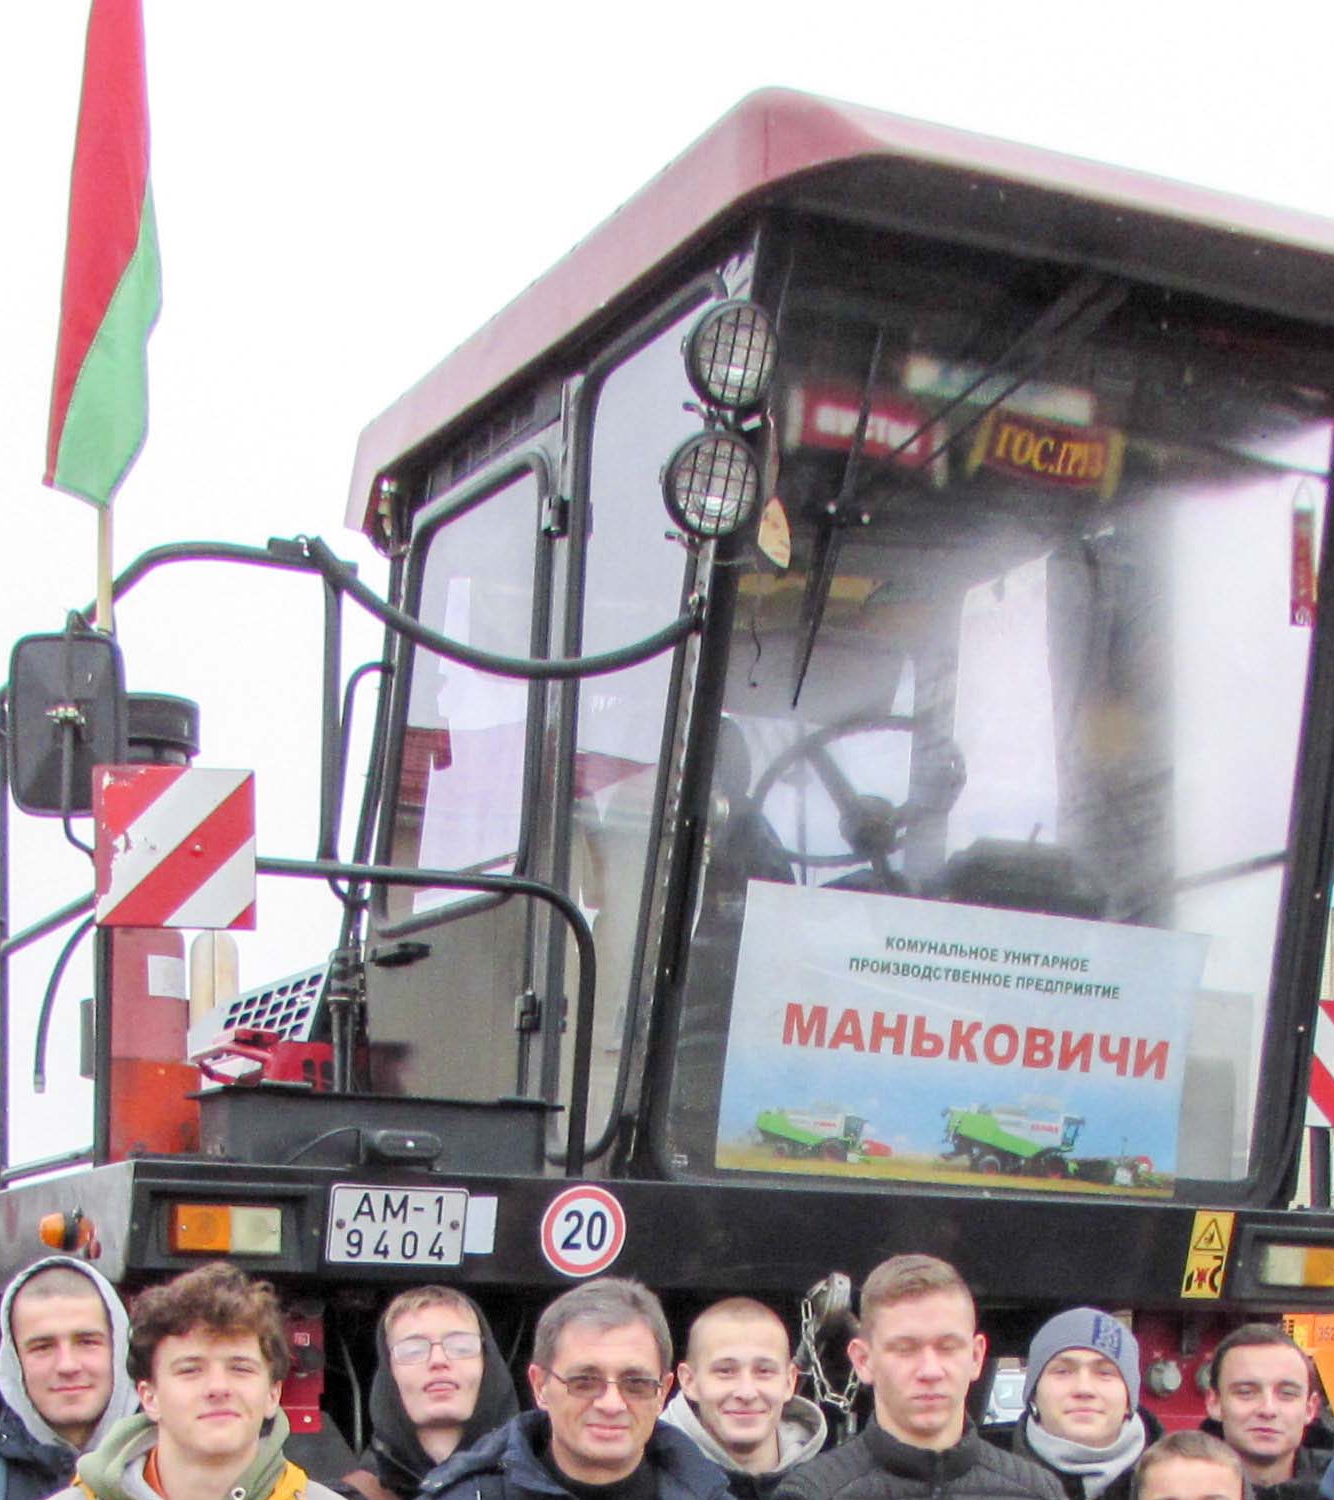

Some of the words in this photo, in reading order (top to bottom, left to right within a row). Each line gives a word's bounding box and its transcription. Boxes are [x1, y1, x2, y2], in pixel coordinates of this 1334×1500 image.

[885, 936, 998, 962] КОМУНАЛЬНОЕ
[1003, 949, 1089, 972] УНИТАРНОЕ
[849, 957, 1011, 988] ПРОИЗВОДСТВЕННОЕ
[1015, 976, 1121, 999] ПРЕДПРИЯТИЕ
[782, 1002, 1169, 1080] МАНЬКОВИЧИ
[353, 1192, 444, 1225] AM-1
[346, 1228, 444, 1261] 9404
[561, 1209, 607, 1252] 20
